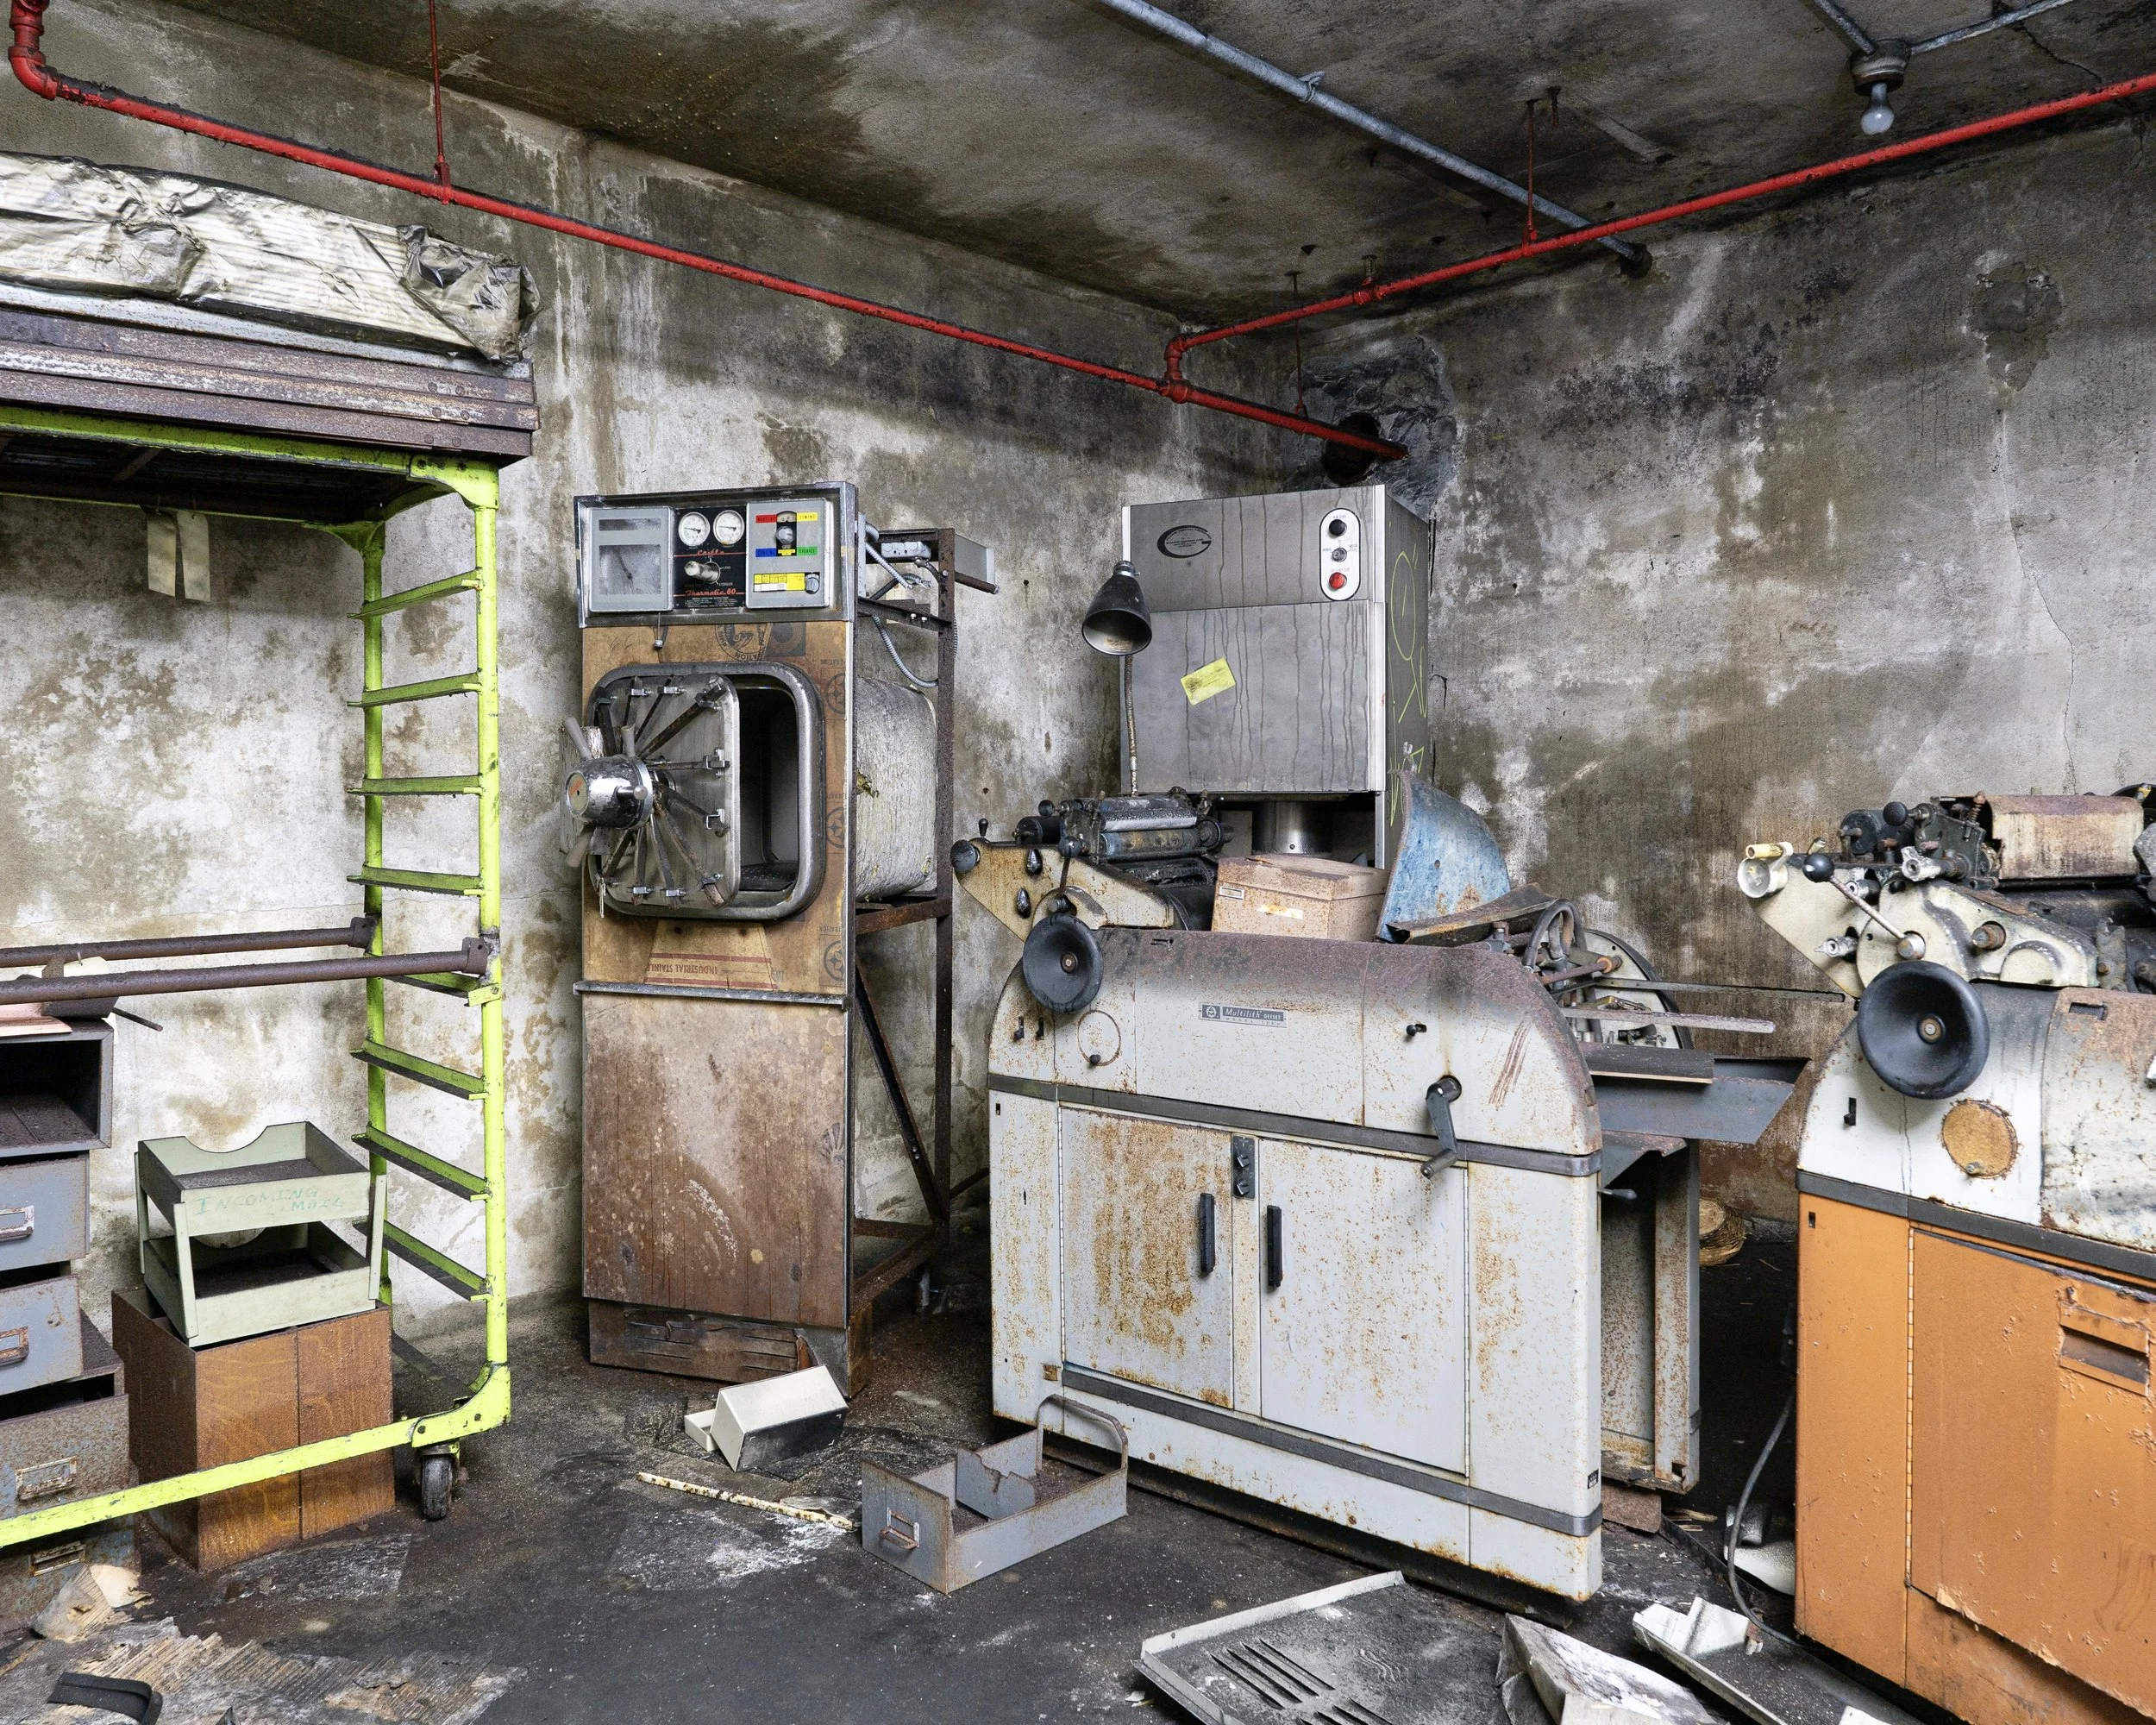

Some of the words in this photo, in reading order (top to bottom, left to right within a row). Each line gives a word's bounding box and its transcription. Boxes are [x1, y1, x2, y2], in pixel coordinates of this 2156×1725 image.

[686, 588, 724, 597] Thermatic
[726, 587, 736, 596] 60
[675, 964, 718, 975] INDUSTRIAL
[1225, 1007, 1261, 1019] Multilith
[195, 1186, 318, 1215] INCOMING
[291, 1197, 343, 1212] MAIL
